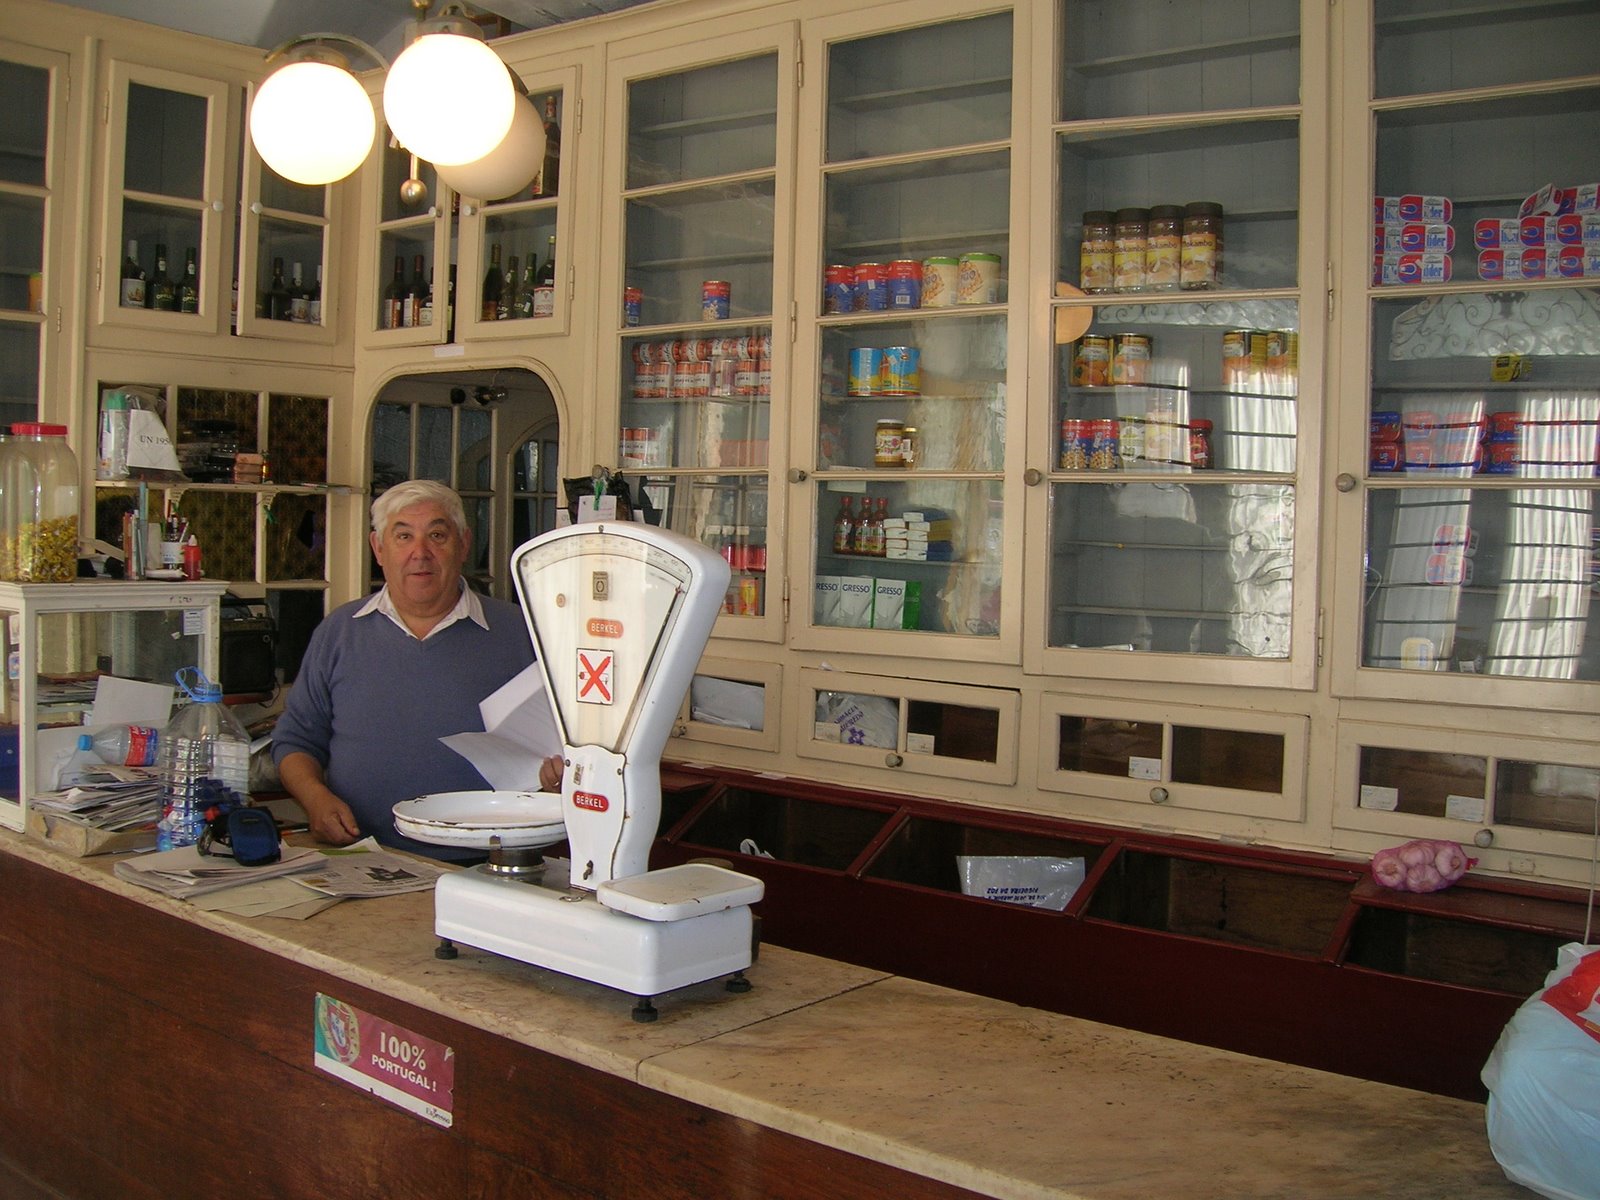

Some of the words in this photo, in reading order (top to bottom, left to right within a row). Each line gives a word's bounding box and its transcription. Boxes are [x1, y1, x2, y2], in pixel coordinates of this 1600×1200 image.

[816, 582, 839, 592] RESSO
[842, 583, 870, 594] GRESSO
[877, 586, 903, 596] GRESSO
[591, 622, 619, 634] BERKEL
[576, 795, 604, 809] BERKEL
[381, 1031, 426, 1070] 100%
